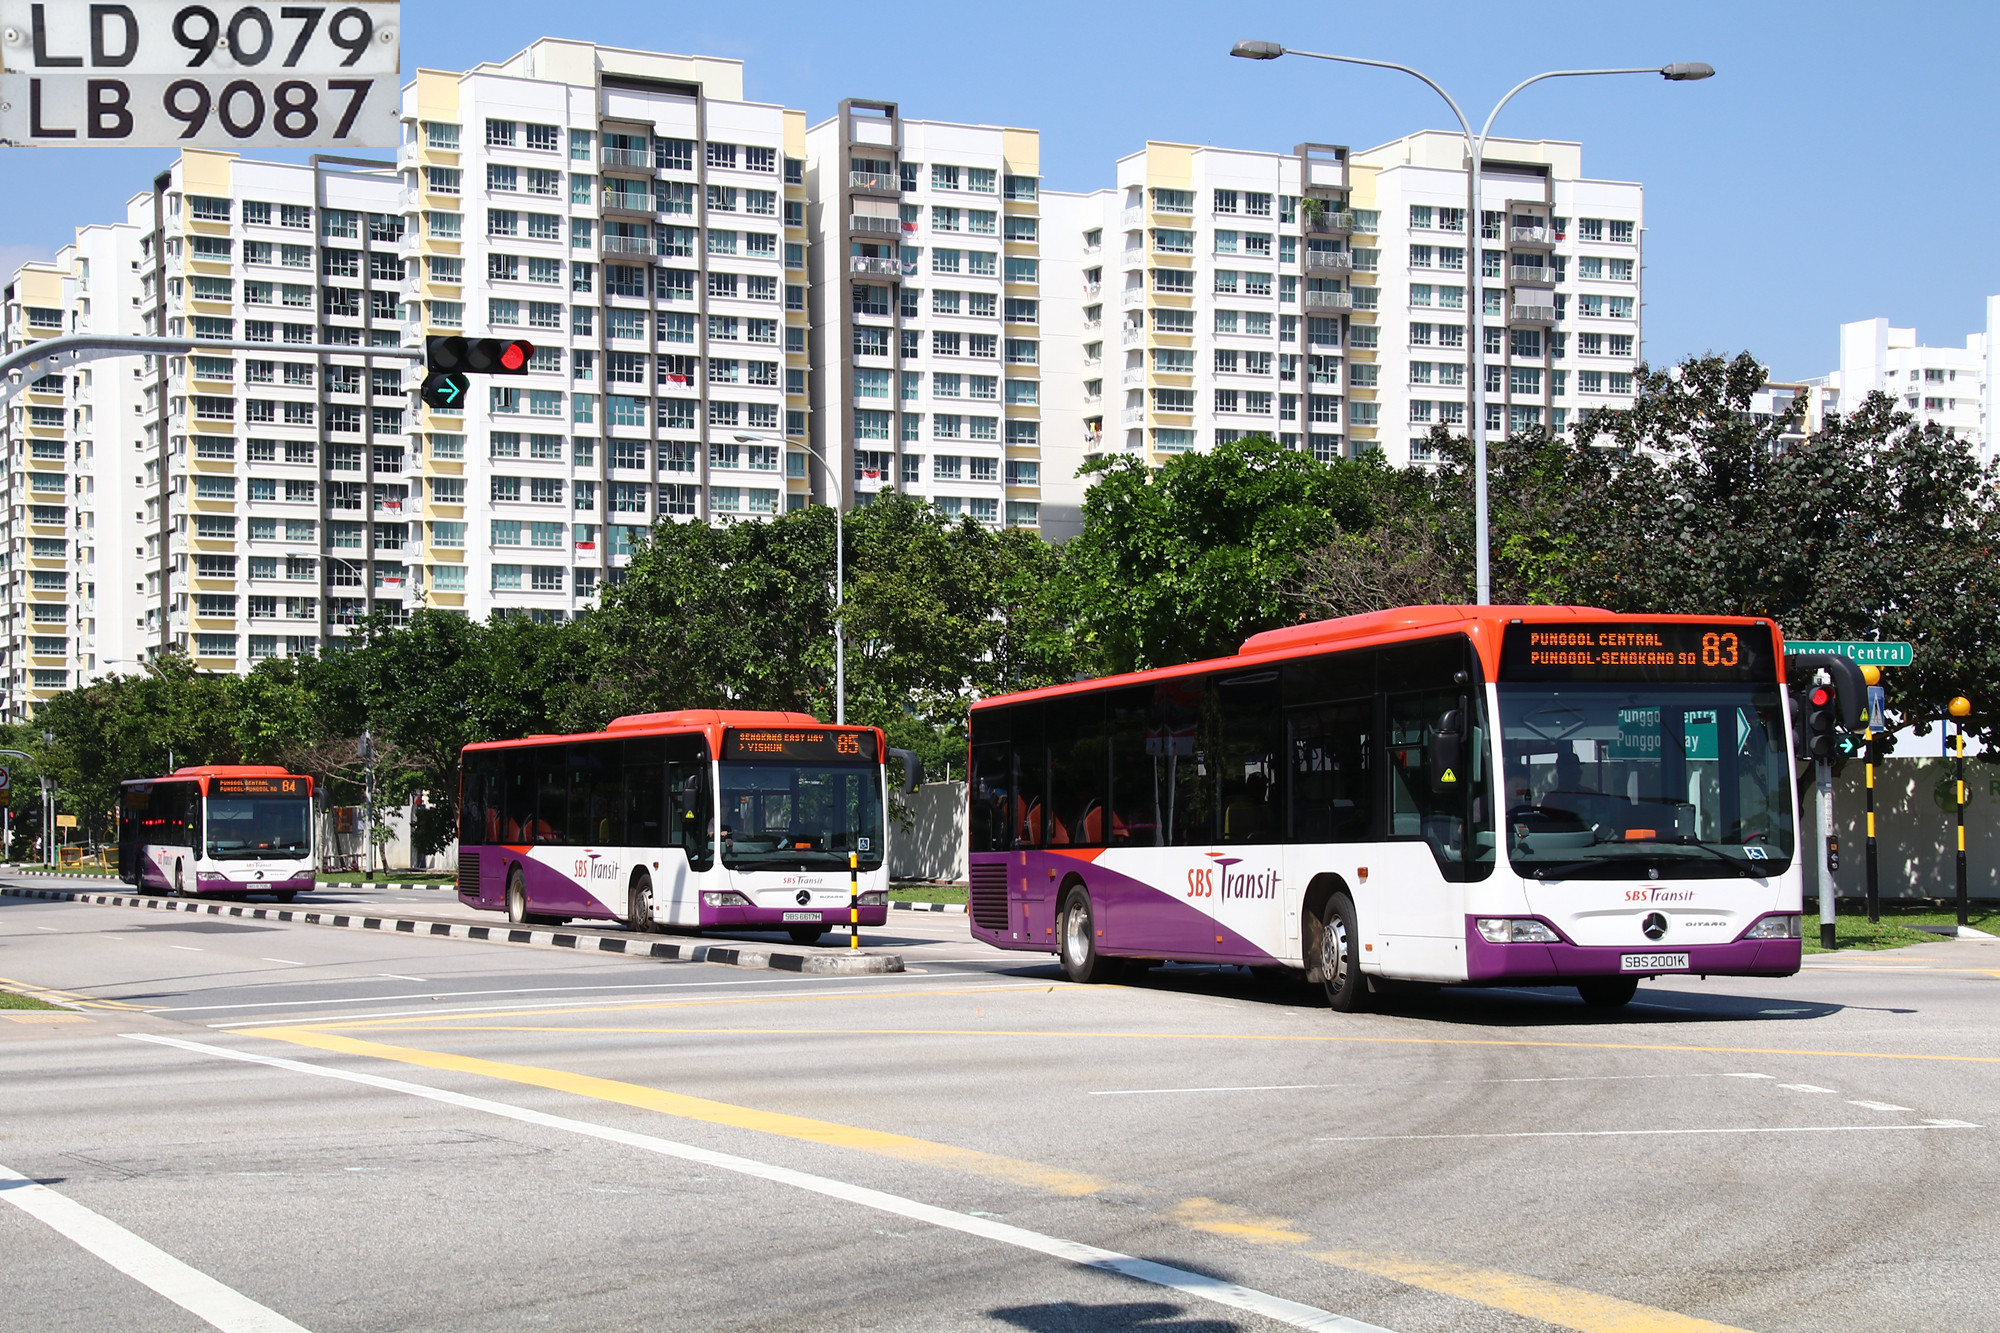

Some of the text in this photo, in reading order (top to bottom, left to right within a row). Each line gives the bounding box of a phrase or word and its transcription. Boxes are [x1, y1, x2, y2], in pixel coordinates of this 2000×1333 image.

[1531, 633, 1663, 646] PUNGGOL CENTRAL
[1702, 632, 1739, 667] 83
[1847, 645, 1904, 660] Central
[784, 733, 806, 742] EAST
[807, 734, 824, 742] WAY
[837, 734, 859, 754] 85
[748, 743, 783, 752] YISHUN
[282, 779, 296, 792] 84
[574, 854, 620, 882] SBS Transit
[796, 875, 823, 885] Transit
[1187, 858, 1283, 906] SBS Transit
[1625, 887, 1699, 903] SBS Transit
